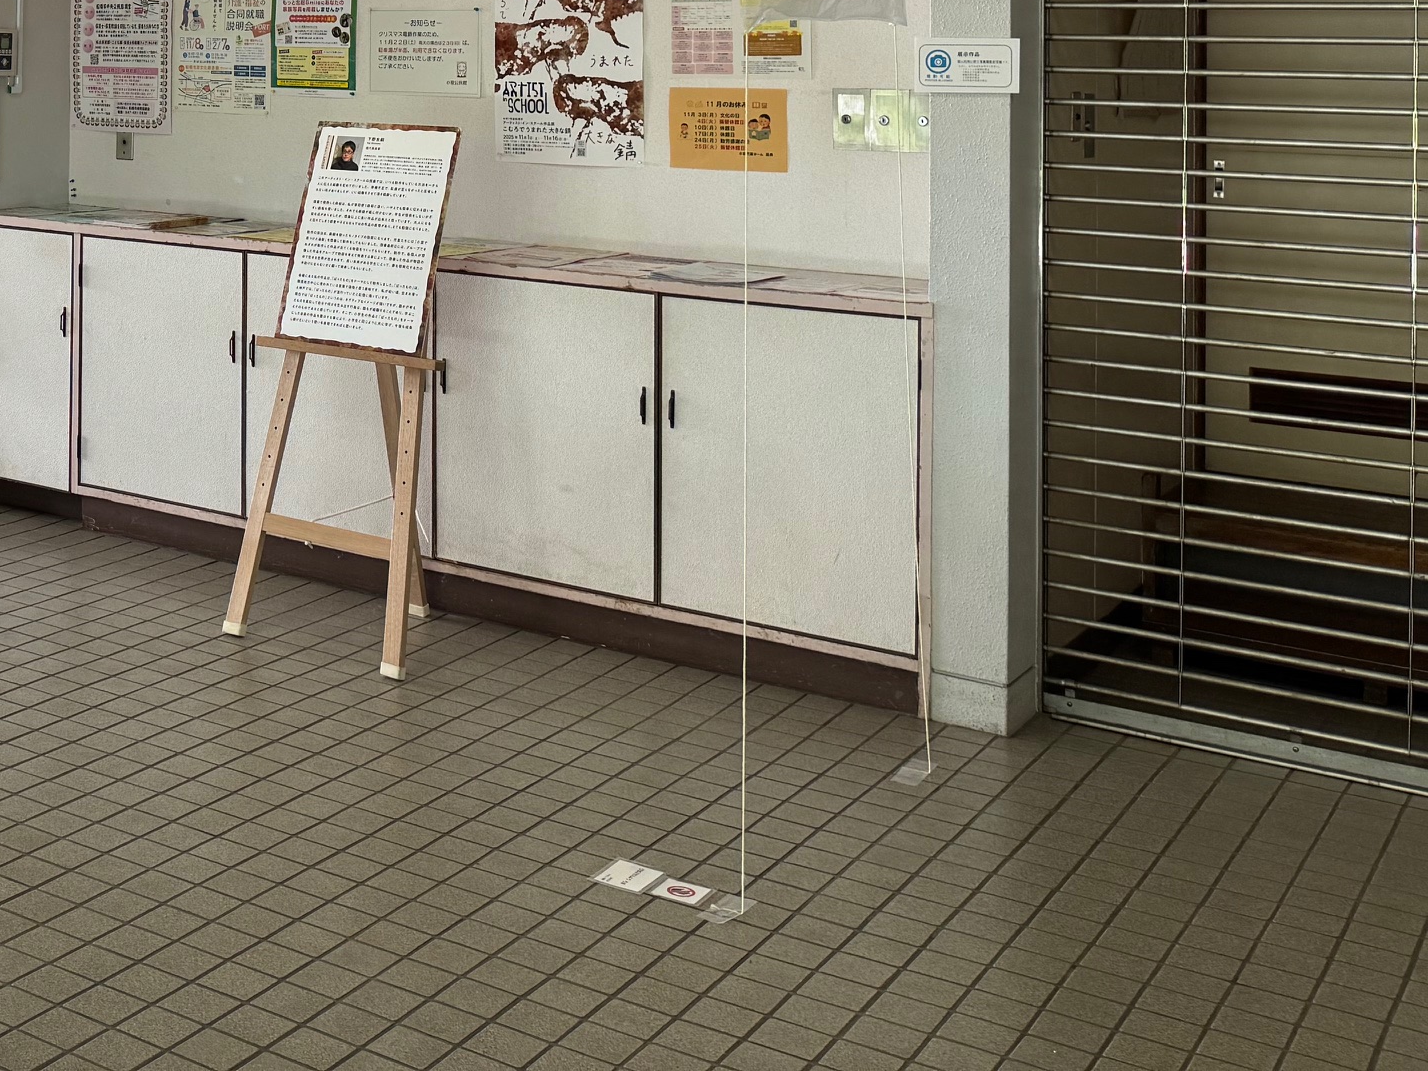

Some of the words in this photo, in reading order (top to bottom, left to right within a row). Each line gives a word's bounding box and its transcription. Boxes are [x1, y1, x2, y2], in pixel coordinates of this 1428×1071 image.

[226, 9, 265, 20] 合同就職
[226, 21, 254, 32] 説明会
[590, 54, 634, 68] うまれた
[508, 92, 550, 115] SCHOOL
[585, 130, 617, 145] 大きな
